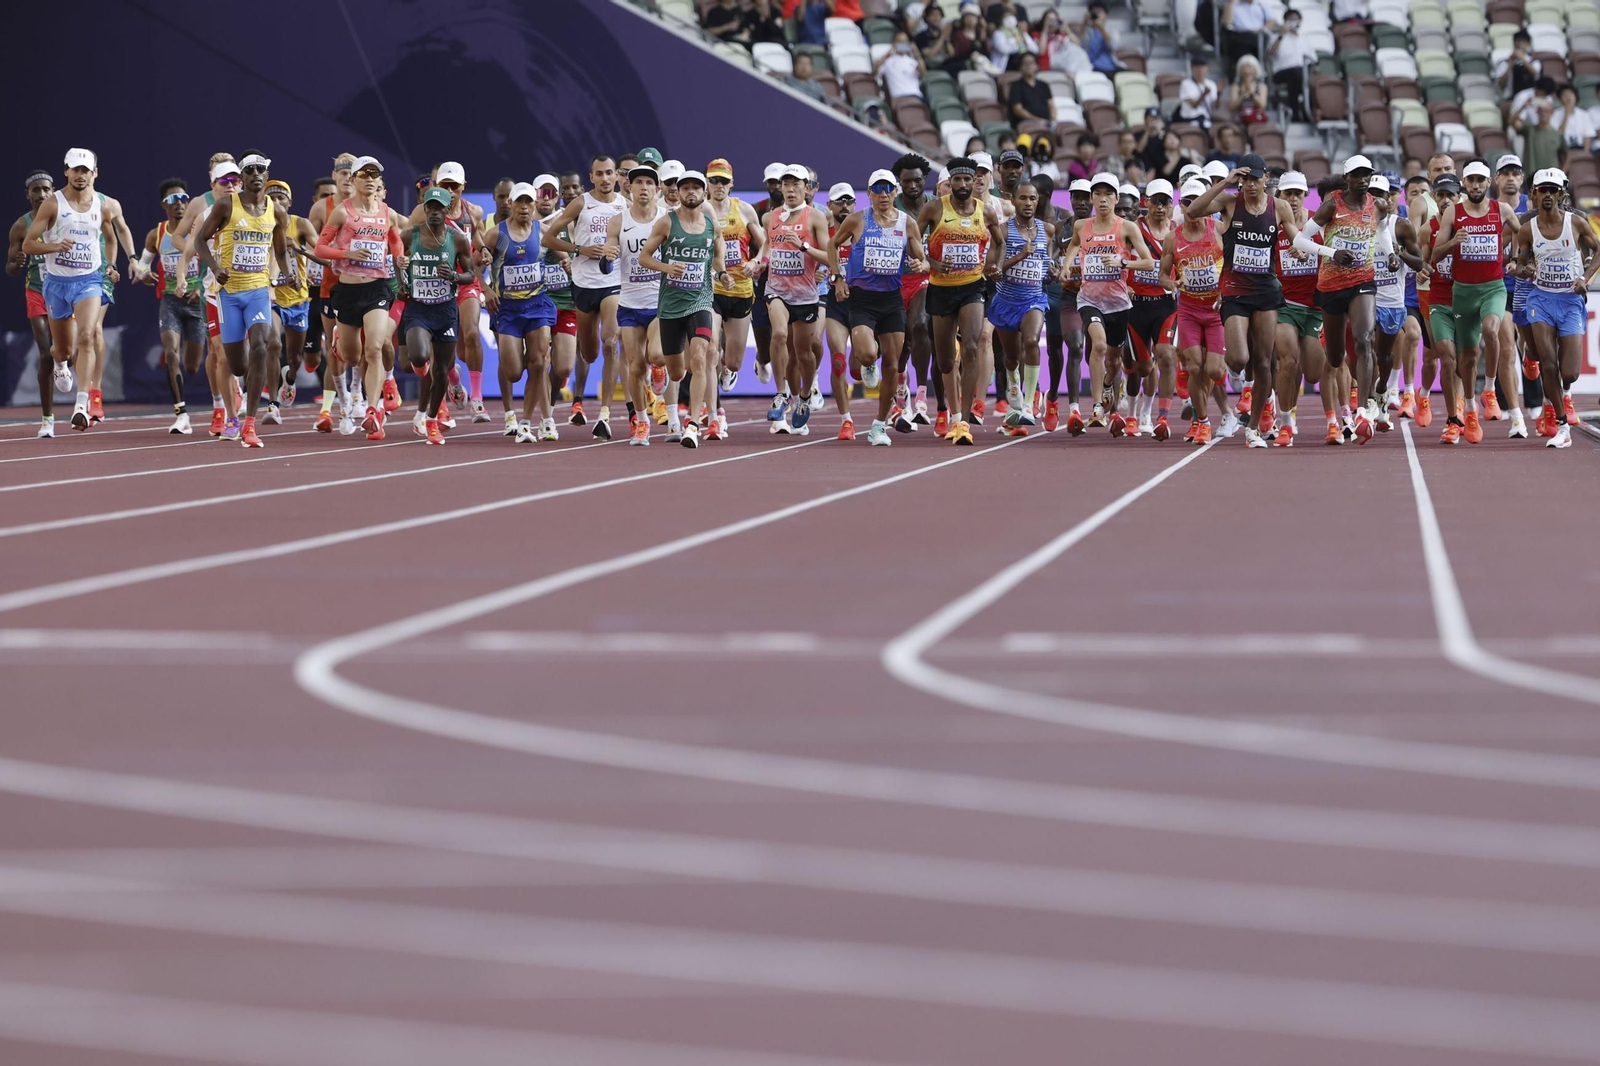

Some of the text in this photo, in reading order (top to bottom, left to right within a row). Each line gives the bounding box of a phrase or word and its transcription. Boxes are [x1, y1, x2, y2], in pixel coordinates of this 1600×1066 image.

[591, 216, 610, 224] GRE
[354, 227, 385, 237] JAPAN
[1336, 225, 1372, 237] KENYA
[1462, 224, 1496, 233] MOROCCO
[945, 233, 980, 241] GERMANY
[1237, 231, 1272, 242] SUDAN
[1471, 235, 1495, 244] TDK
[74, 242, 92, 251] DK
[245, 245, 267, 254] TDK
[362, 241, 383, 251] TDK
[954, 245, 976, 253] TDK
[1343, 240, 1367, 250] TDK
[777, 250, 800, 259] TDK
[876, 248, 900, 257] TDK
[1086, 245, 1116, 255] JAPAN
[1246, 248, 1268, 257] TDK
[368, 252, 383, 261] NDO
[1180, 254, 1215, 268] CHINA
[1234, 256, 1269, 266] ABDALLA
[771, 260, 803, 269] KOYAMA
[865, 258, 900, 267] BAT-OCHIR
[1282, 260, 1290, 269] EL
[412, 264, 438, 277] IRELA
[513, 264, 538, 274] TDK
[1189, 267, 1215, 277] TDK
[1546, 264, 1570, 272] TDK
[1010, 267, 1041, 279] TEFERI
[1540, 271, 1572, 281] CRIPPA
[423, 279, 447, 288] TDK
[511, 274, 536, 284] JAMI
[1187, 277, 1215, 286] YANG
[418, 288, 447, 297] HASO
